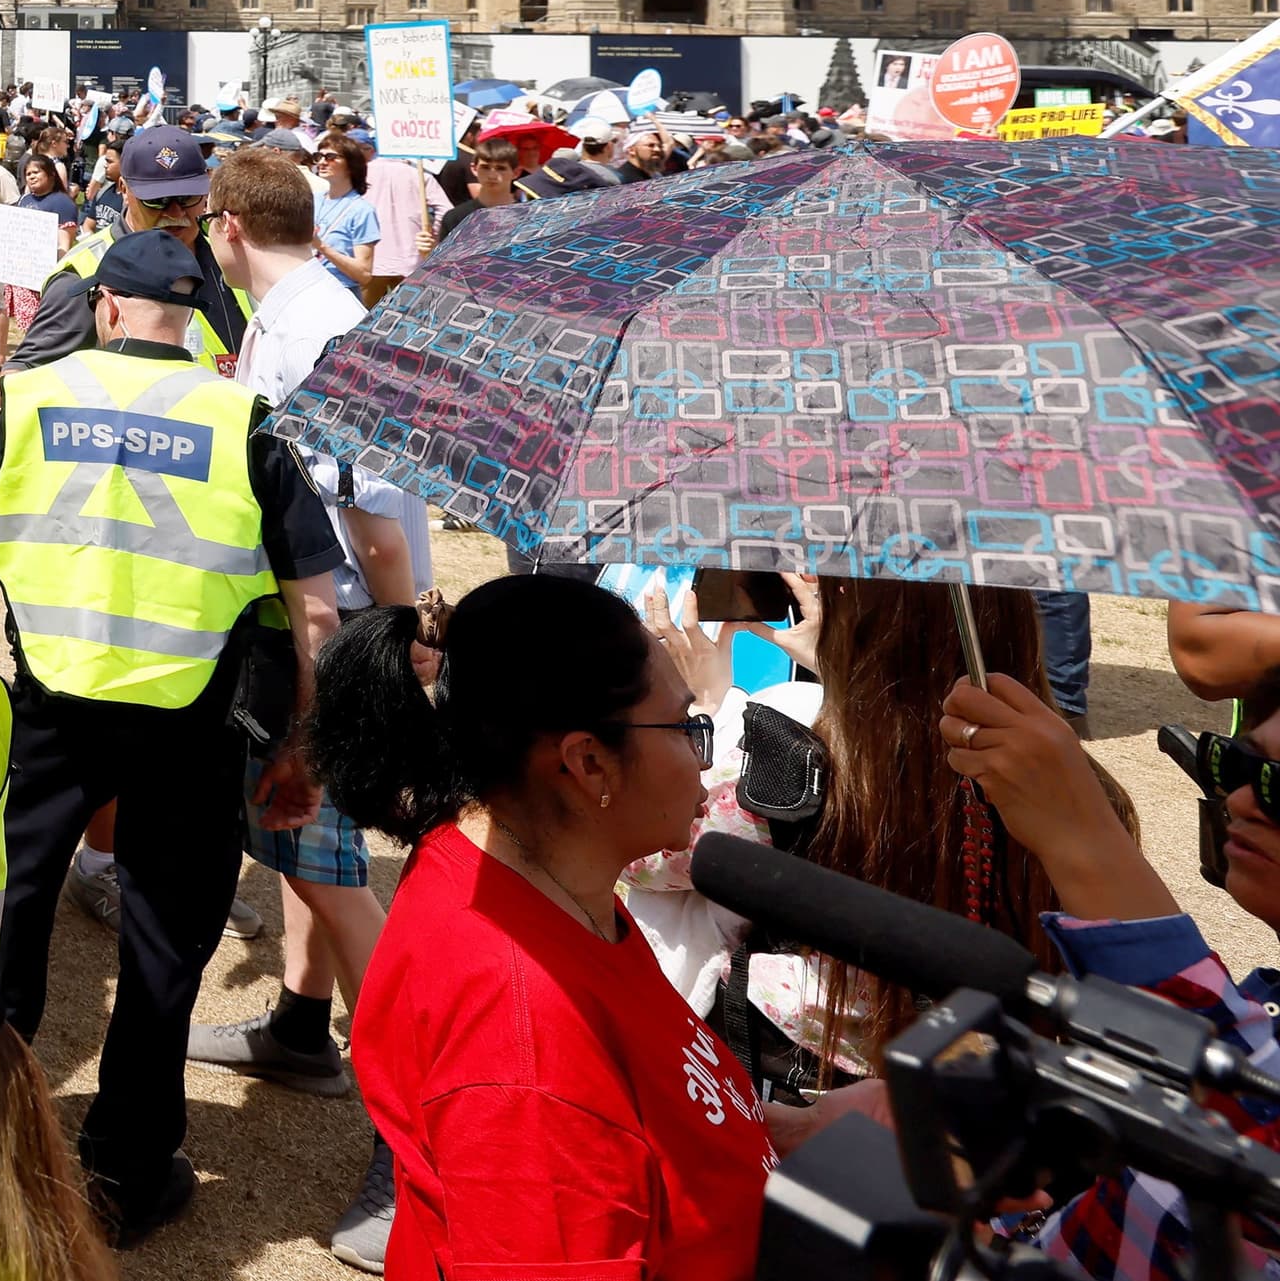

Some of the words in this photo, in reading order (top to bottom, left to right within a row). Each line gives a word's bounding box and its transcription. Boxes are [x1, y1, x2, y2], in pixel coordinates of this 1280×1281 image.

[384, 56, 436, 80] CHANCE
[952, 51, 961, 72] I
[963, 44, 1004, 71] AM
[380, 87, 412, 104] NONE
[391, 120, 442, 139] CHOICE
[52, 422, 195, 461] PPS-SPP
